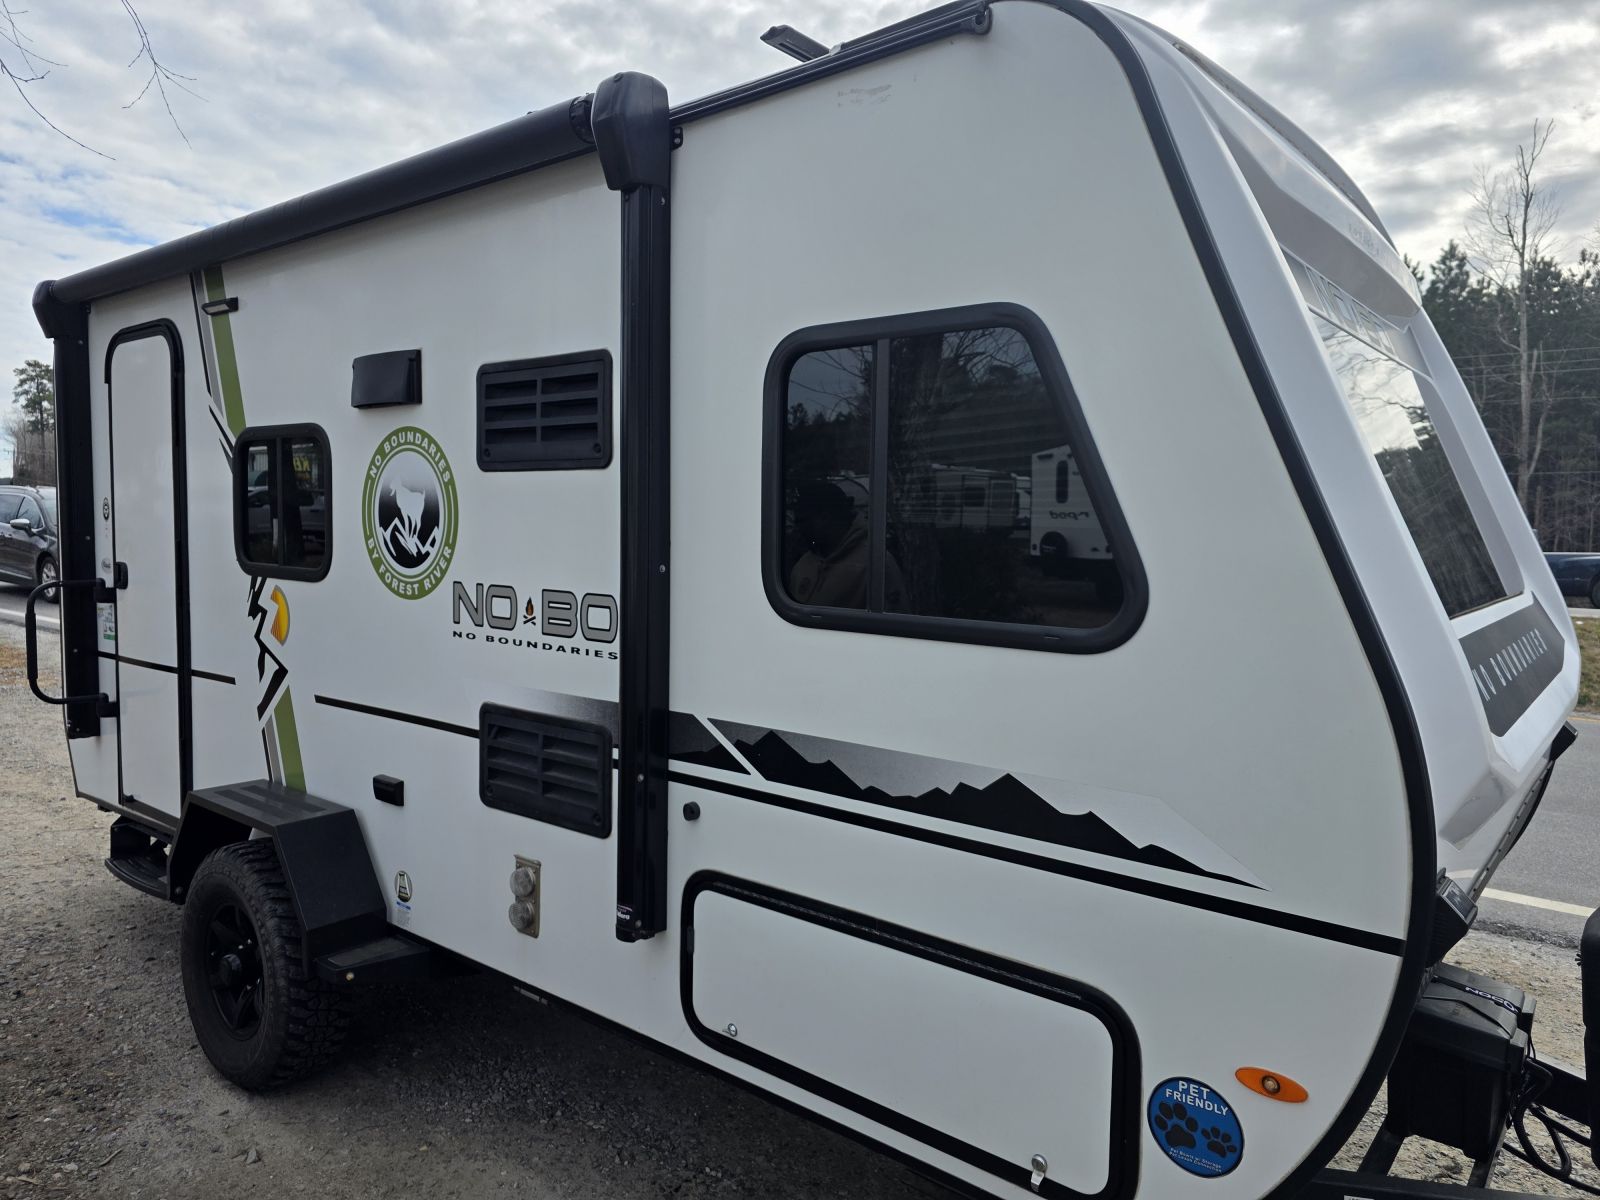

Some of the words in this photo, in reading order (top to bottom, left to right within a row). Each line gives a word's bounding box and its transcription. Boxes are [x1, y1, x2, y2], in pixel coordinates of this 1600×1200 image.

[369, 455, 382, 478] NO
[384, 430, 450, 482] BOUNDARIES
[367, 537, 379, 560] BY
[379, 565, 419, 595] FOREST
[424, 546, 452, 590] RIVER
[452, 580, 518, 631] NO
[541, 588, 619, 644] BO
[452, 630, 477, 640] NO
[485, 634, 619, 660] BOUNDARIES
[1472, 664, 1497, 702] NO
[1490, 628, 1548, 687] BOUNDARIES
[1165, 1088, 1229, 1116] FRIENDLY
[1178, 1080, 1210, 1100] PET
